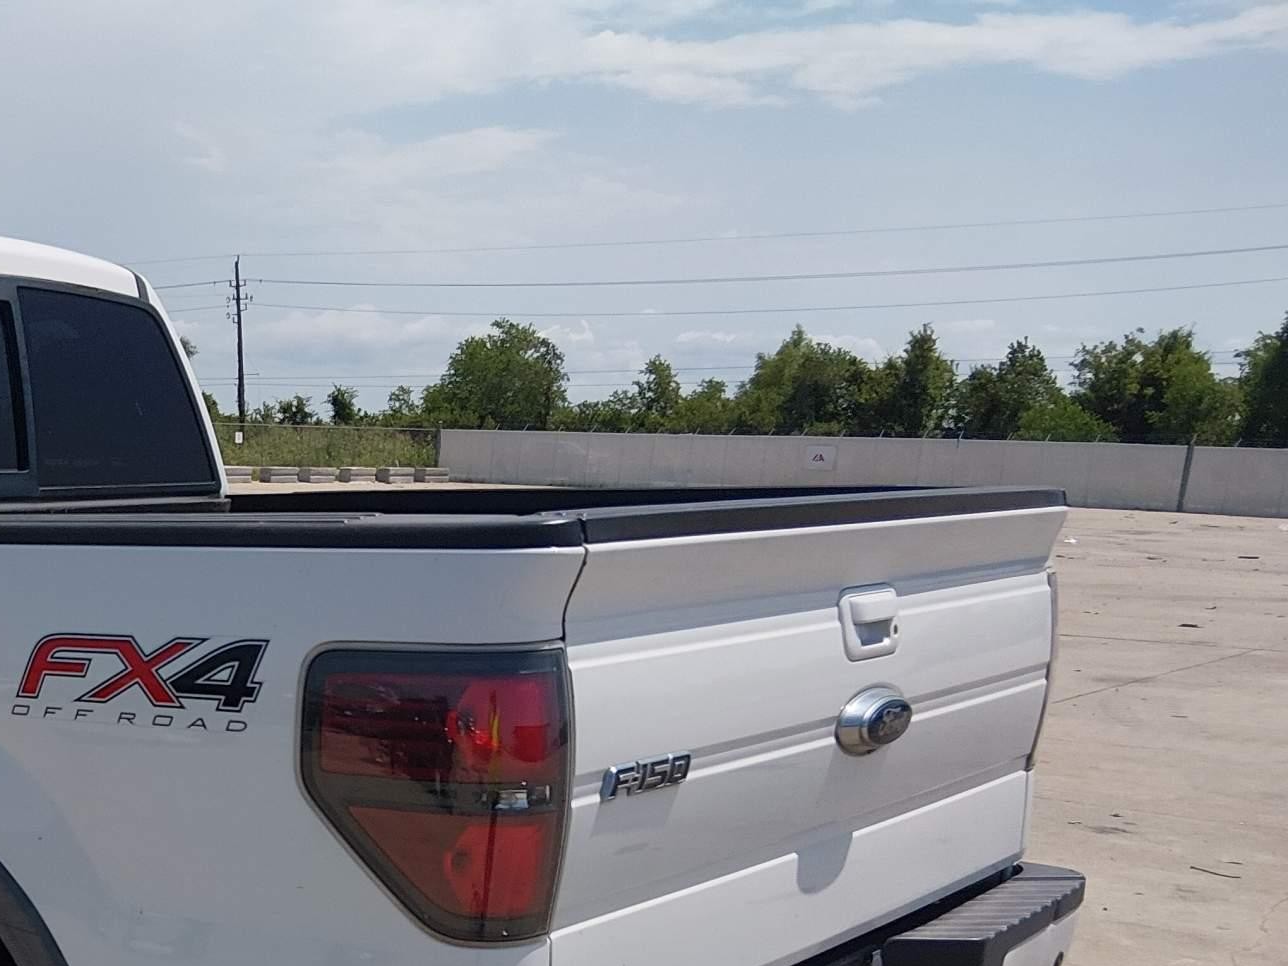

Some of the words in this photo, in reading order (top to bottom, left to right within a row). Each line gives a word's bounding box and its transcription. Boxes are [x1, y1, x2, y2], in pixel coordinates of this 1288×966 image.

[15, 632, 271, 713] FX4
[11, 704, 94, 721] OFF
[116, 712, 248, 733] ROAD
